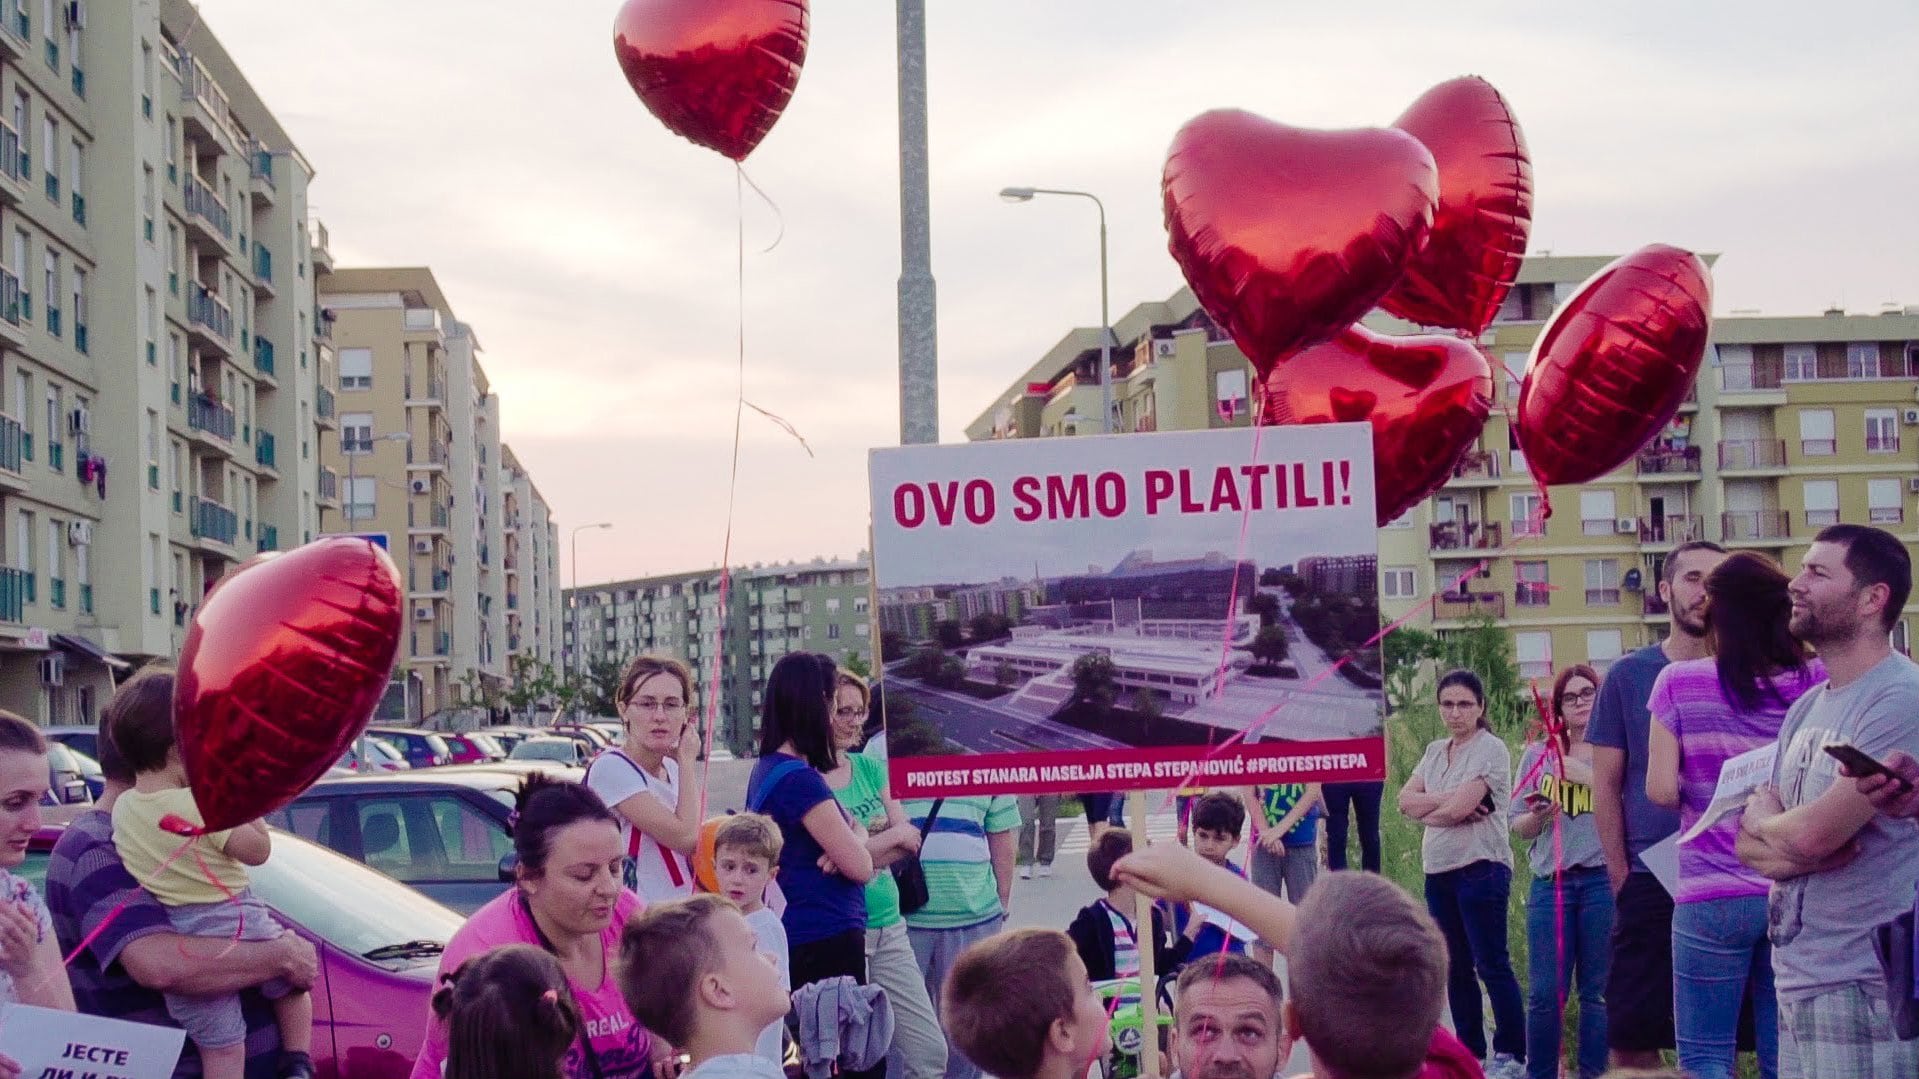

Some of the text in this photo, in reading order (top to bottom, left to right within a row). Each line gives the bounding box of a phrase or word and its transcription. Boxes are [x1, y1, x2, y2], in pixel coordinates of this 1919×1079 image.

[893, 460, 1351, 529] OVO SMO PLATILI!
[907, 753, 1368, 787] PROTEST STANARA NASELJA STEPA STEPANOVIĆ #PROTESTSTEPA
[586, 1011, 630, 1039] REAL
[62, 1043, 129, 1066] ЈЕСТЕ
